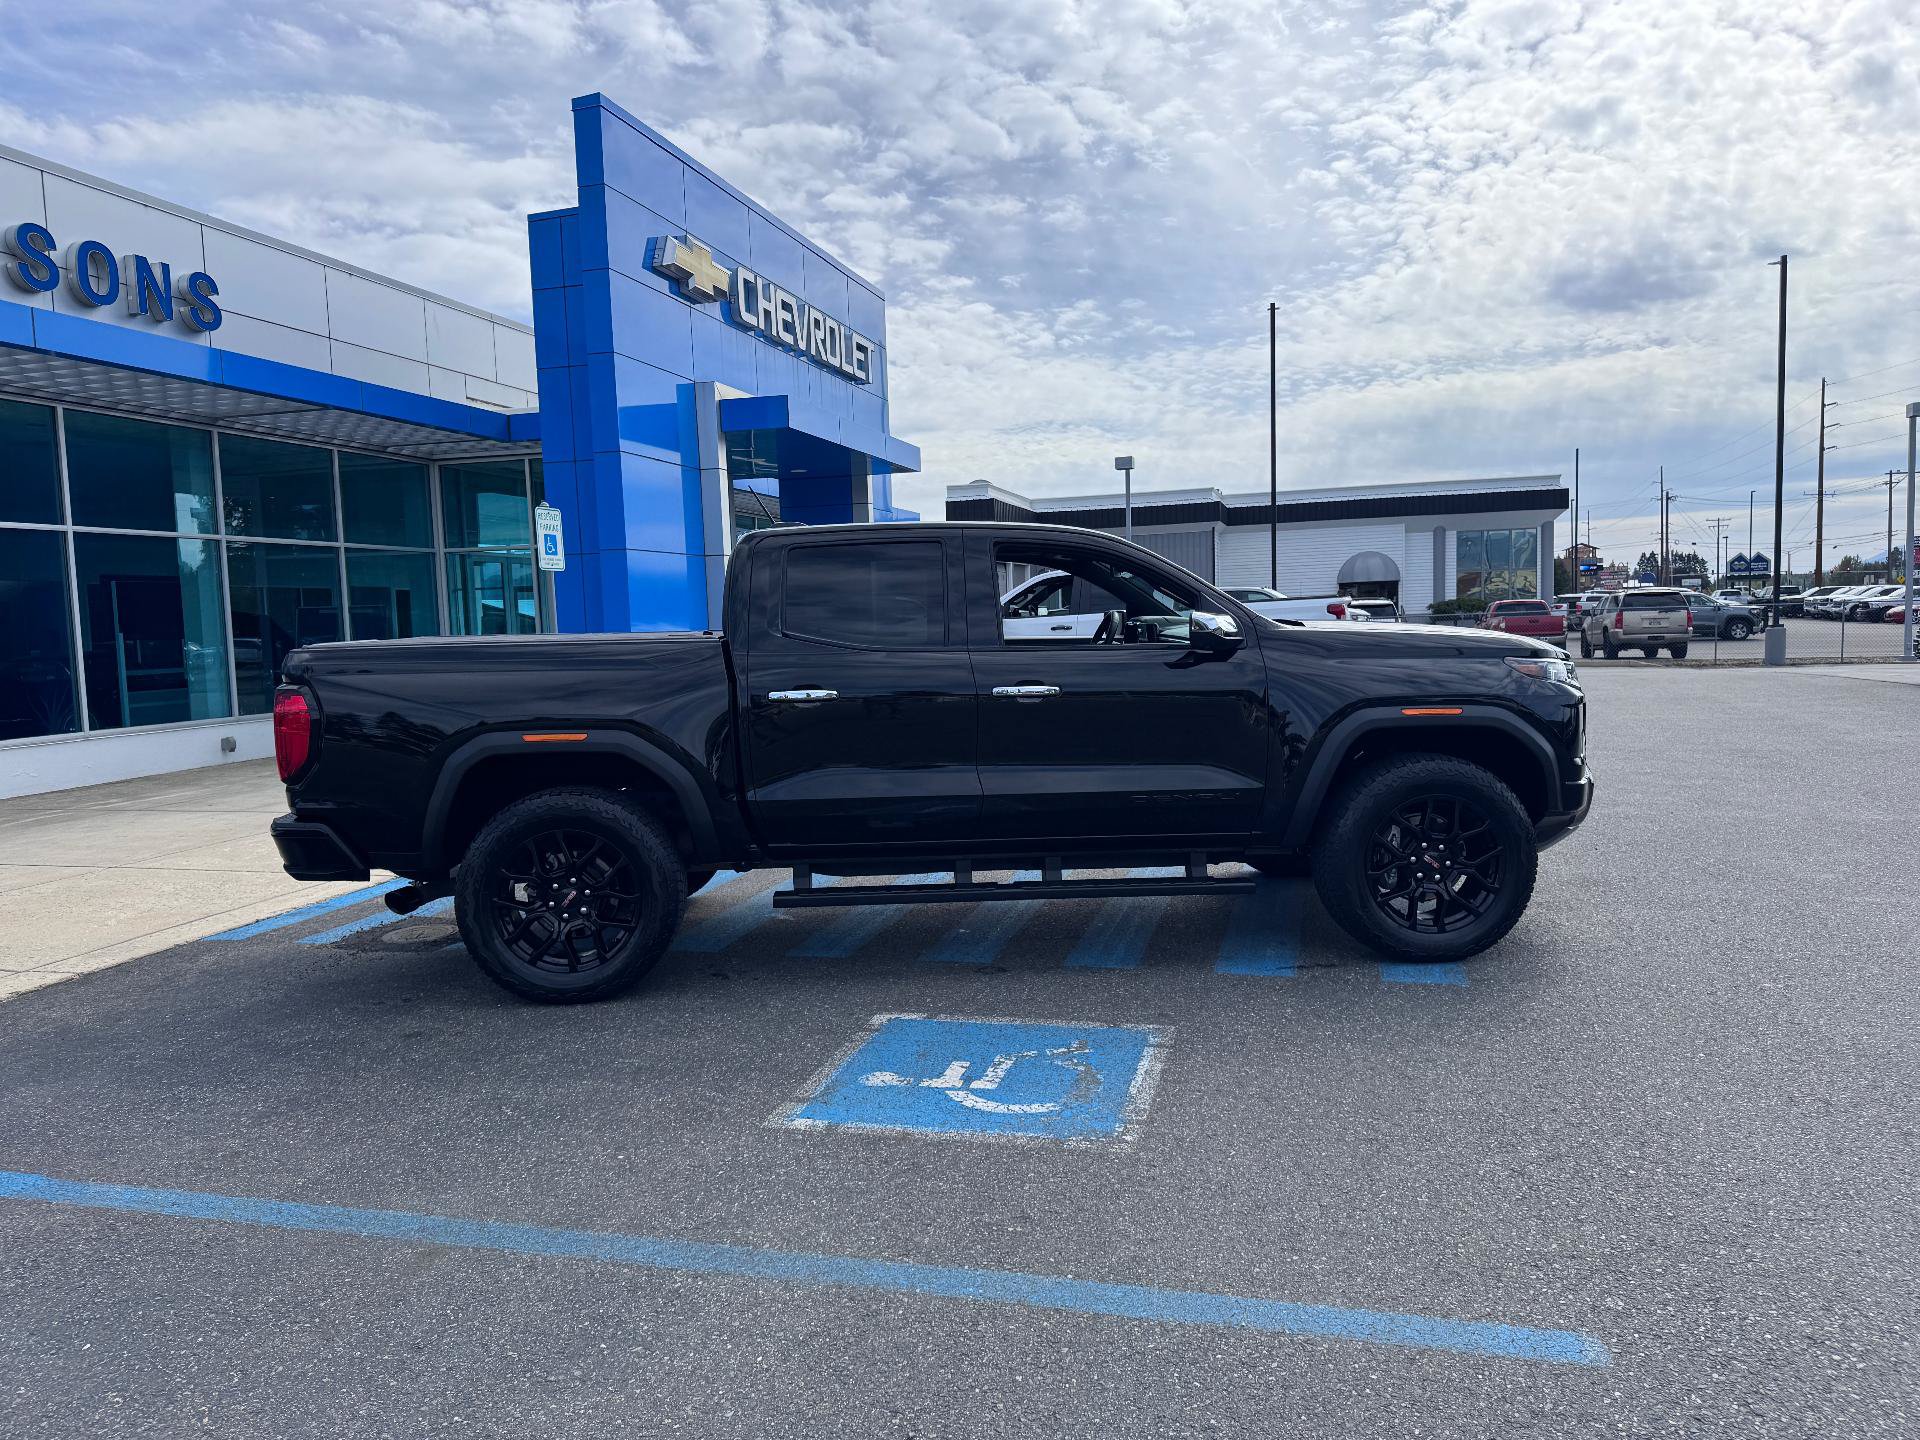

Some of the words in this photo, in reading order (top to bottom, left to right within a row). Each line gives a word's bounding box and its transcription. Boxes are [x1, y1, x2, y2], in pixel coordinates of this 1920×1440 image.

[6, 222, 223, 332] SONS
[736, 266, 875, 384] CHEVROLET
[537, 511, 560, 522] RESERVED
